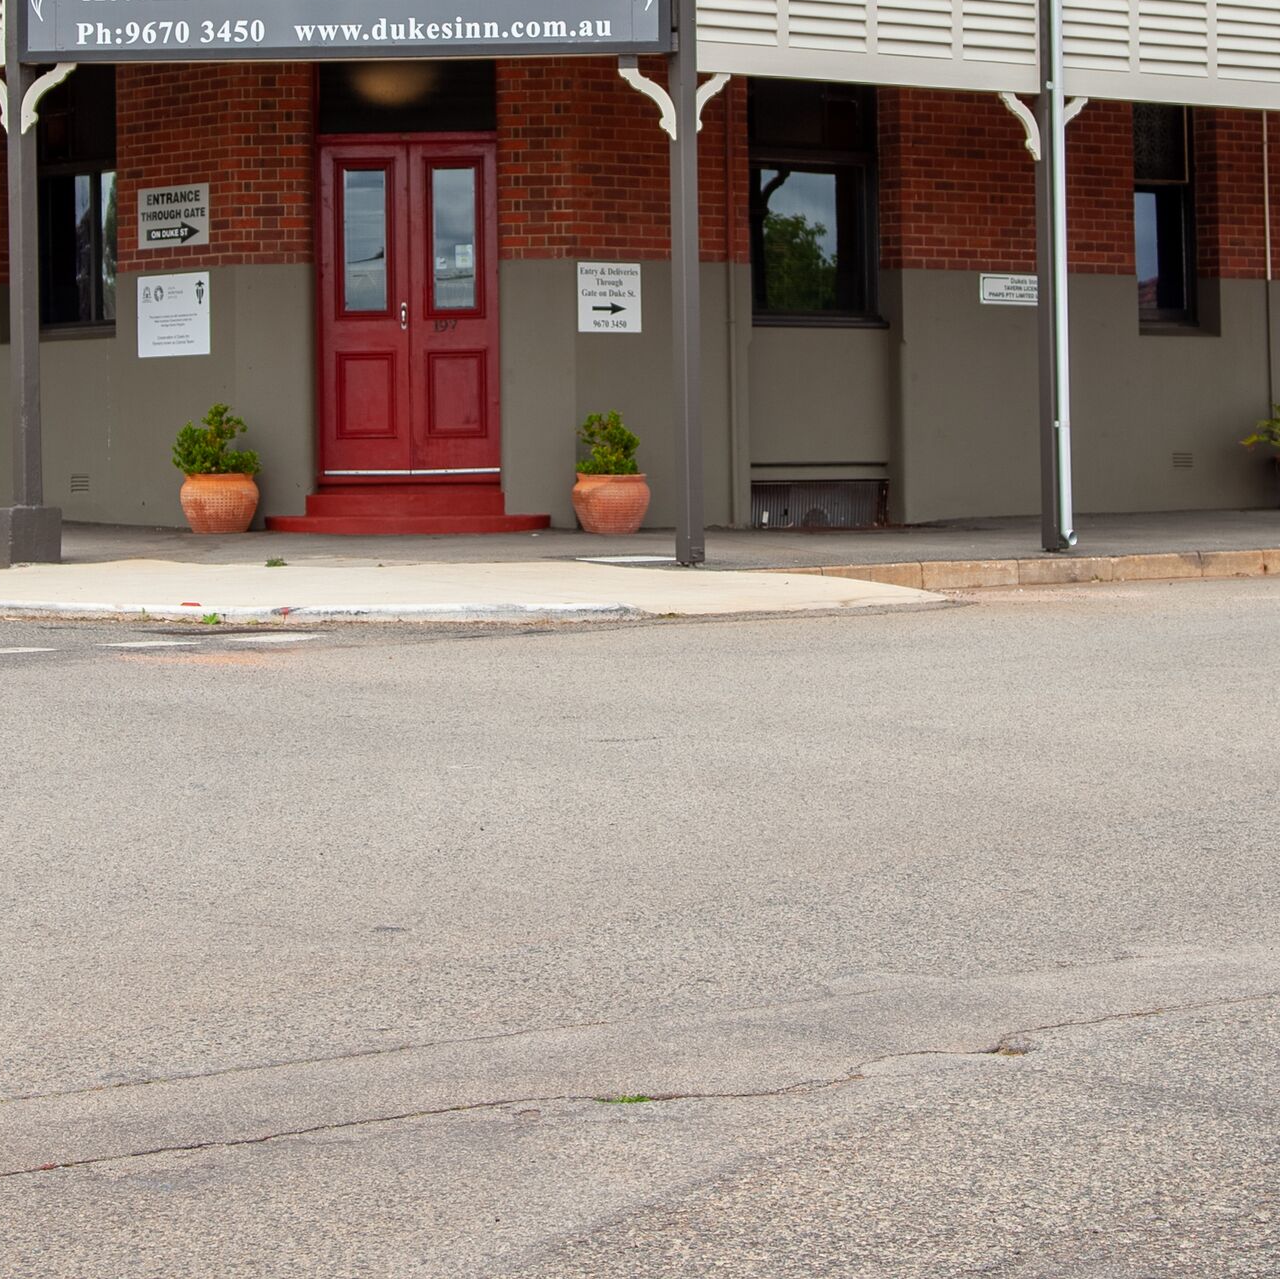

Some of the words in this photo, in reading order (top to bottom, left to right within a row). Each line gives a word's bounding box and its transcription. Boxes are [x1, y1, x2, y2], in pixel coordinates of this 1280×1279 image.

[76, 22, 189, 46] Ph:9670
[200, 20, 265, 43] 3450
[294, 15, 612, 41] www.dukesinn.com.au
[146, 190, 200, 206] ENTRANCE
[141, 209, 181, 222] THROUGH
[183, 207, 206, 218] GATE
[151, 230, 161, 239] ON
[161, 229, 180, 239] DUKE
[180, 228, 189, 237] ST
[580, 267, 598, 277] Entry
[608, 267, 639, 276] Deliveries
[596, 278, 623, 287] Through
[581, 288, 597, 297] Gate
[609, 289, 626, 297] Duke
[593, 320, 609, 328] 9670
[611, 320, 627, 328] 3450
